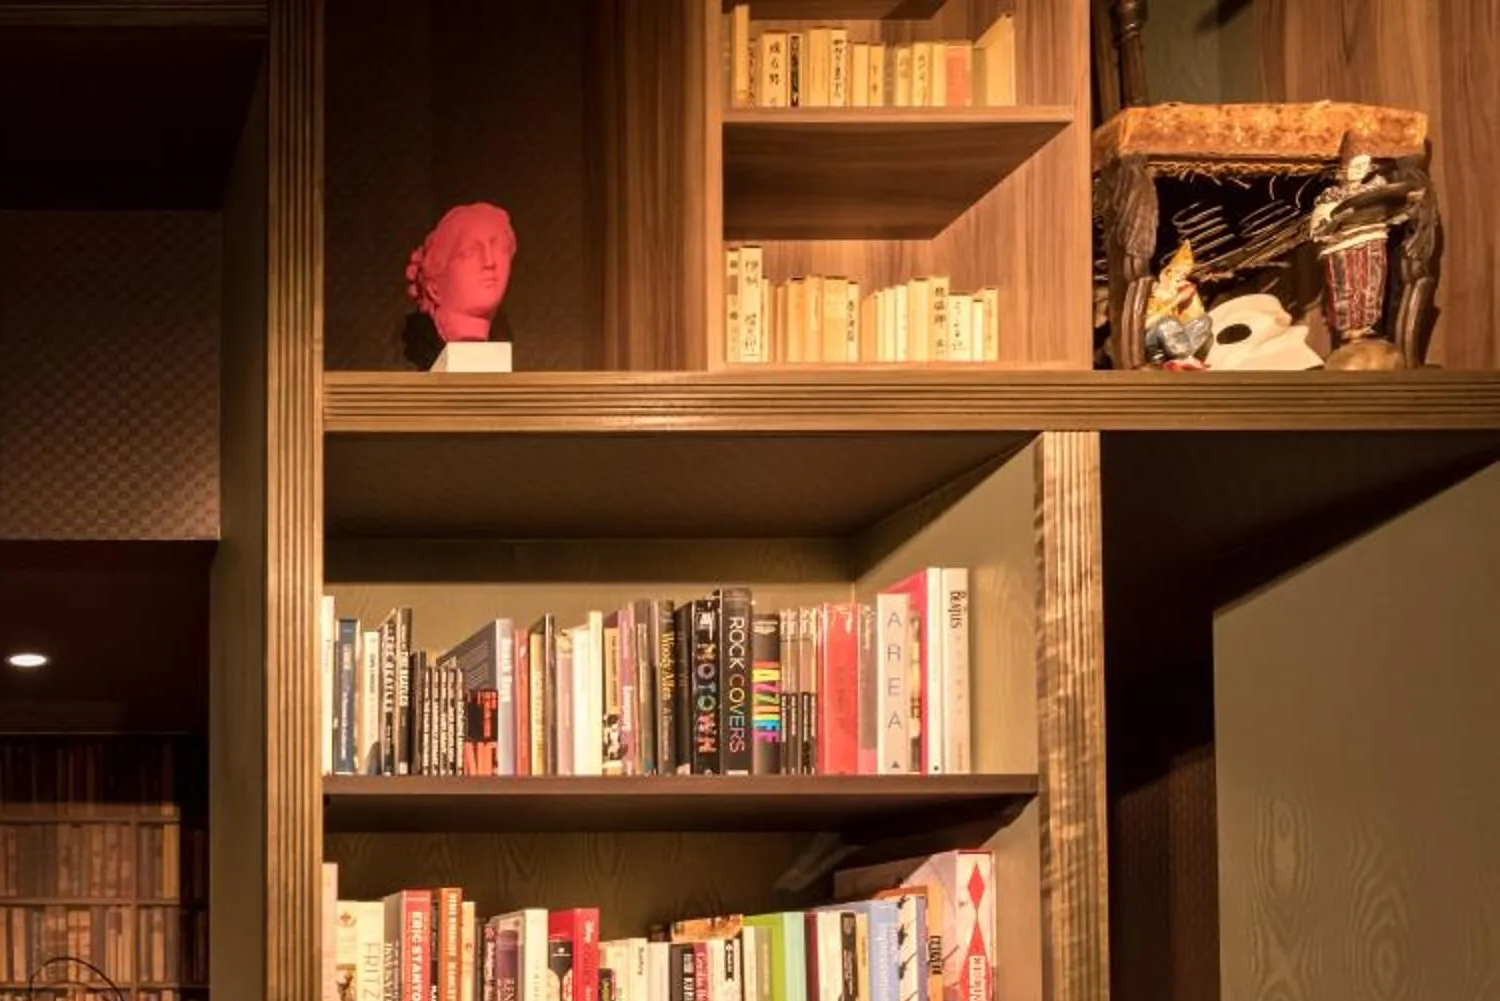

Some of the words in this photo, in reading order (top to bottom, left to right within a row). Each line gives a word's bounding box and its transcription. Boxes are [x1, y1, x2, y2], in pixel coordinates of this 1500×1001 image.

[948, 591, 964, 629] BEATLES
[660, 631, 674, 668] Woody
[728, 616, 745, 669] ROCK
[400, 669, 408, 707] BEATLES
[662, 671, 674, 701] Allen
[887, 612, 902, 729] AREA
[698, 643, 717, 753] MOTOWN
[728, 673, 745, 753] COVERS
[411, 911, 422, 943] ERIC
[363, 943, 381, 1000] FRITZ
